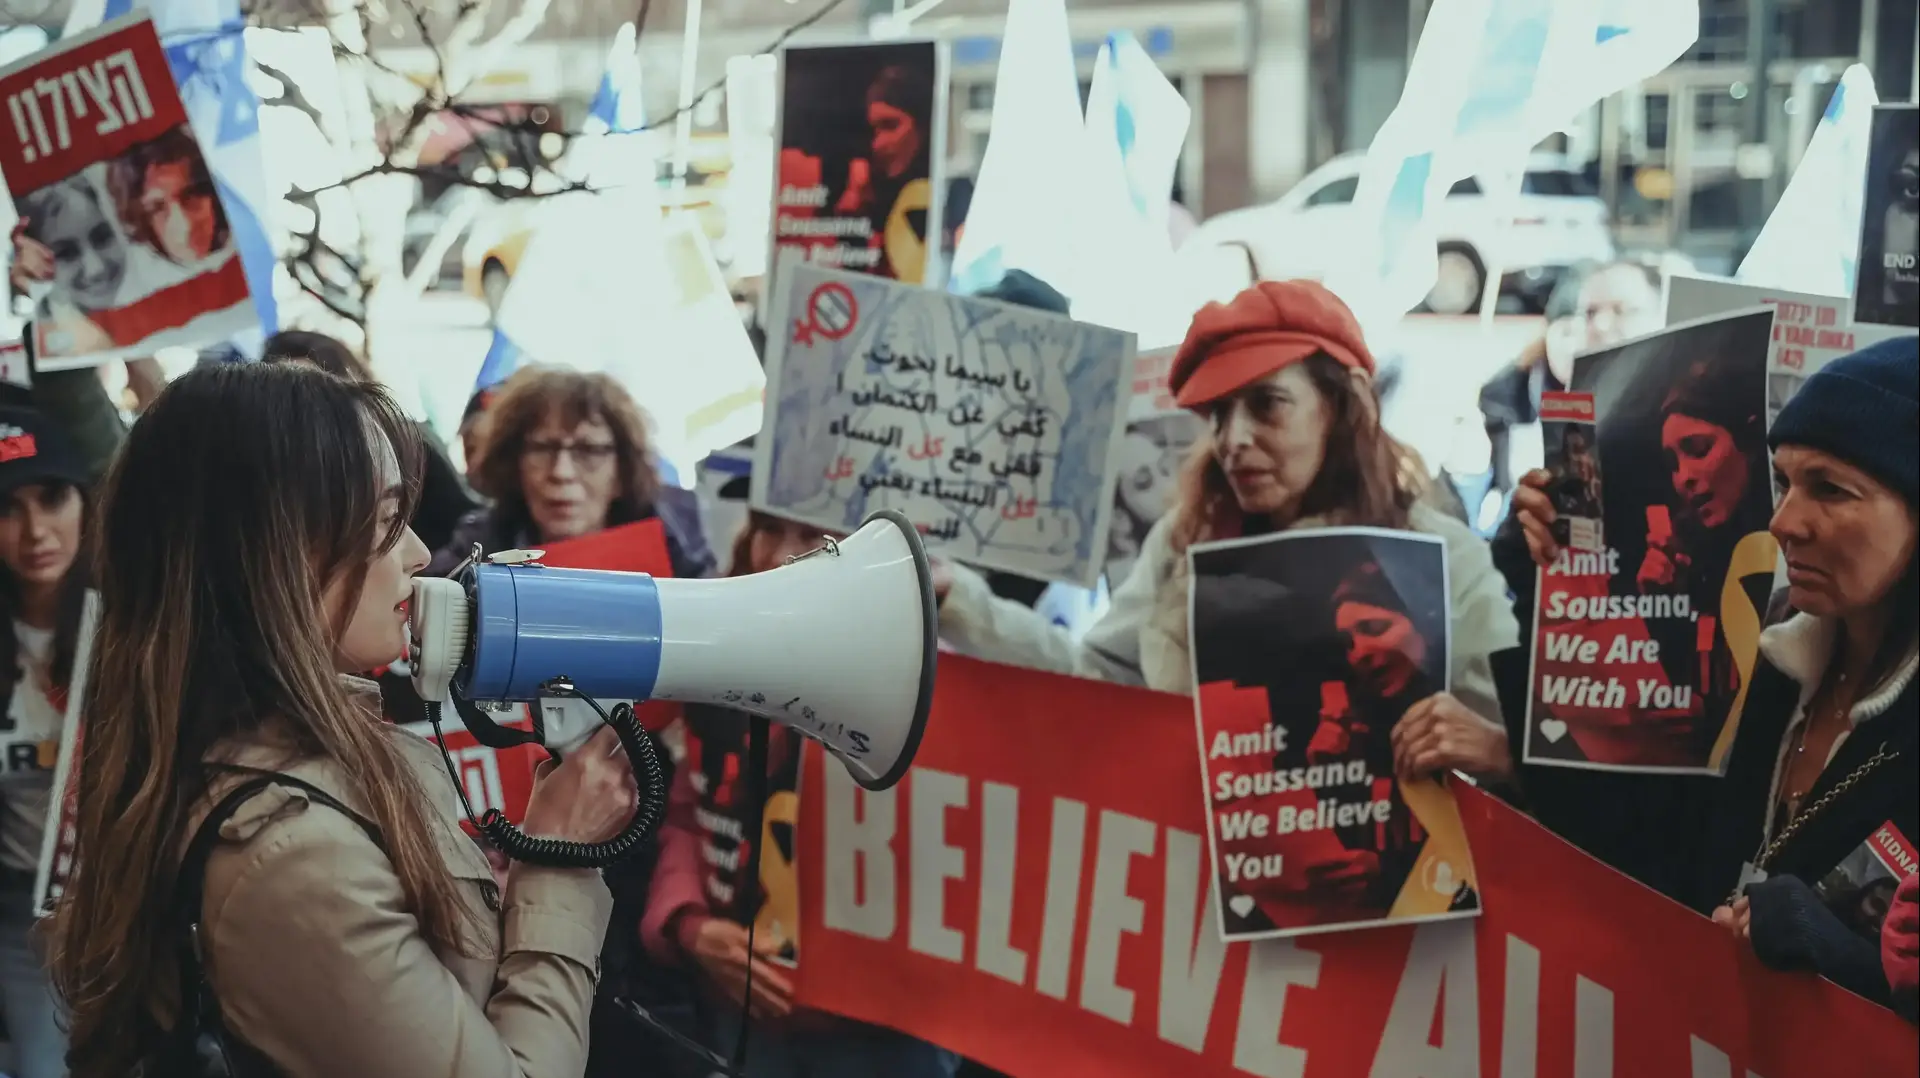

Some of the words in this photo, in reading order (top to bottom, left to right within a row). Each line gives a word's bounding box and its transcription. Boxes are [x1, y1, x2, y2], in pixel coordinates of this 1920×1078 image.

[7, 47, 155, 163] הצילו!
[1883, 252, 1915, 269] END
[907, 433, 945, 460] كل
[1547, 545, 1620, 576] Amit
[1545, 591, 1699, 622] Soussana,
[1545, 632, 1600, 663] We
[1604, 634, 1660, 664] Are
[1541, 674, 1626, 707] With
[1636, 678, 1692, 709] You
[1209, 723, 1288, 760] Amit
[1214, 760, 1374, 801] Soussana,
[1219, 810, 1269, 841] We
[1277, 797, 1391, 836] Believe
[1224, 852, 1283, 883] You
[823, 748, 1323, 1078] BELIEVE
